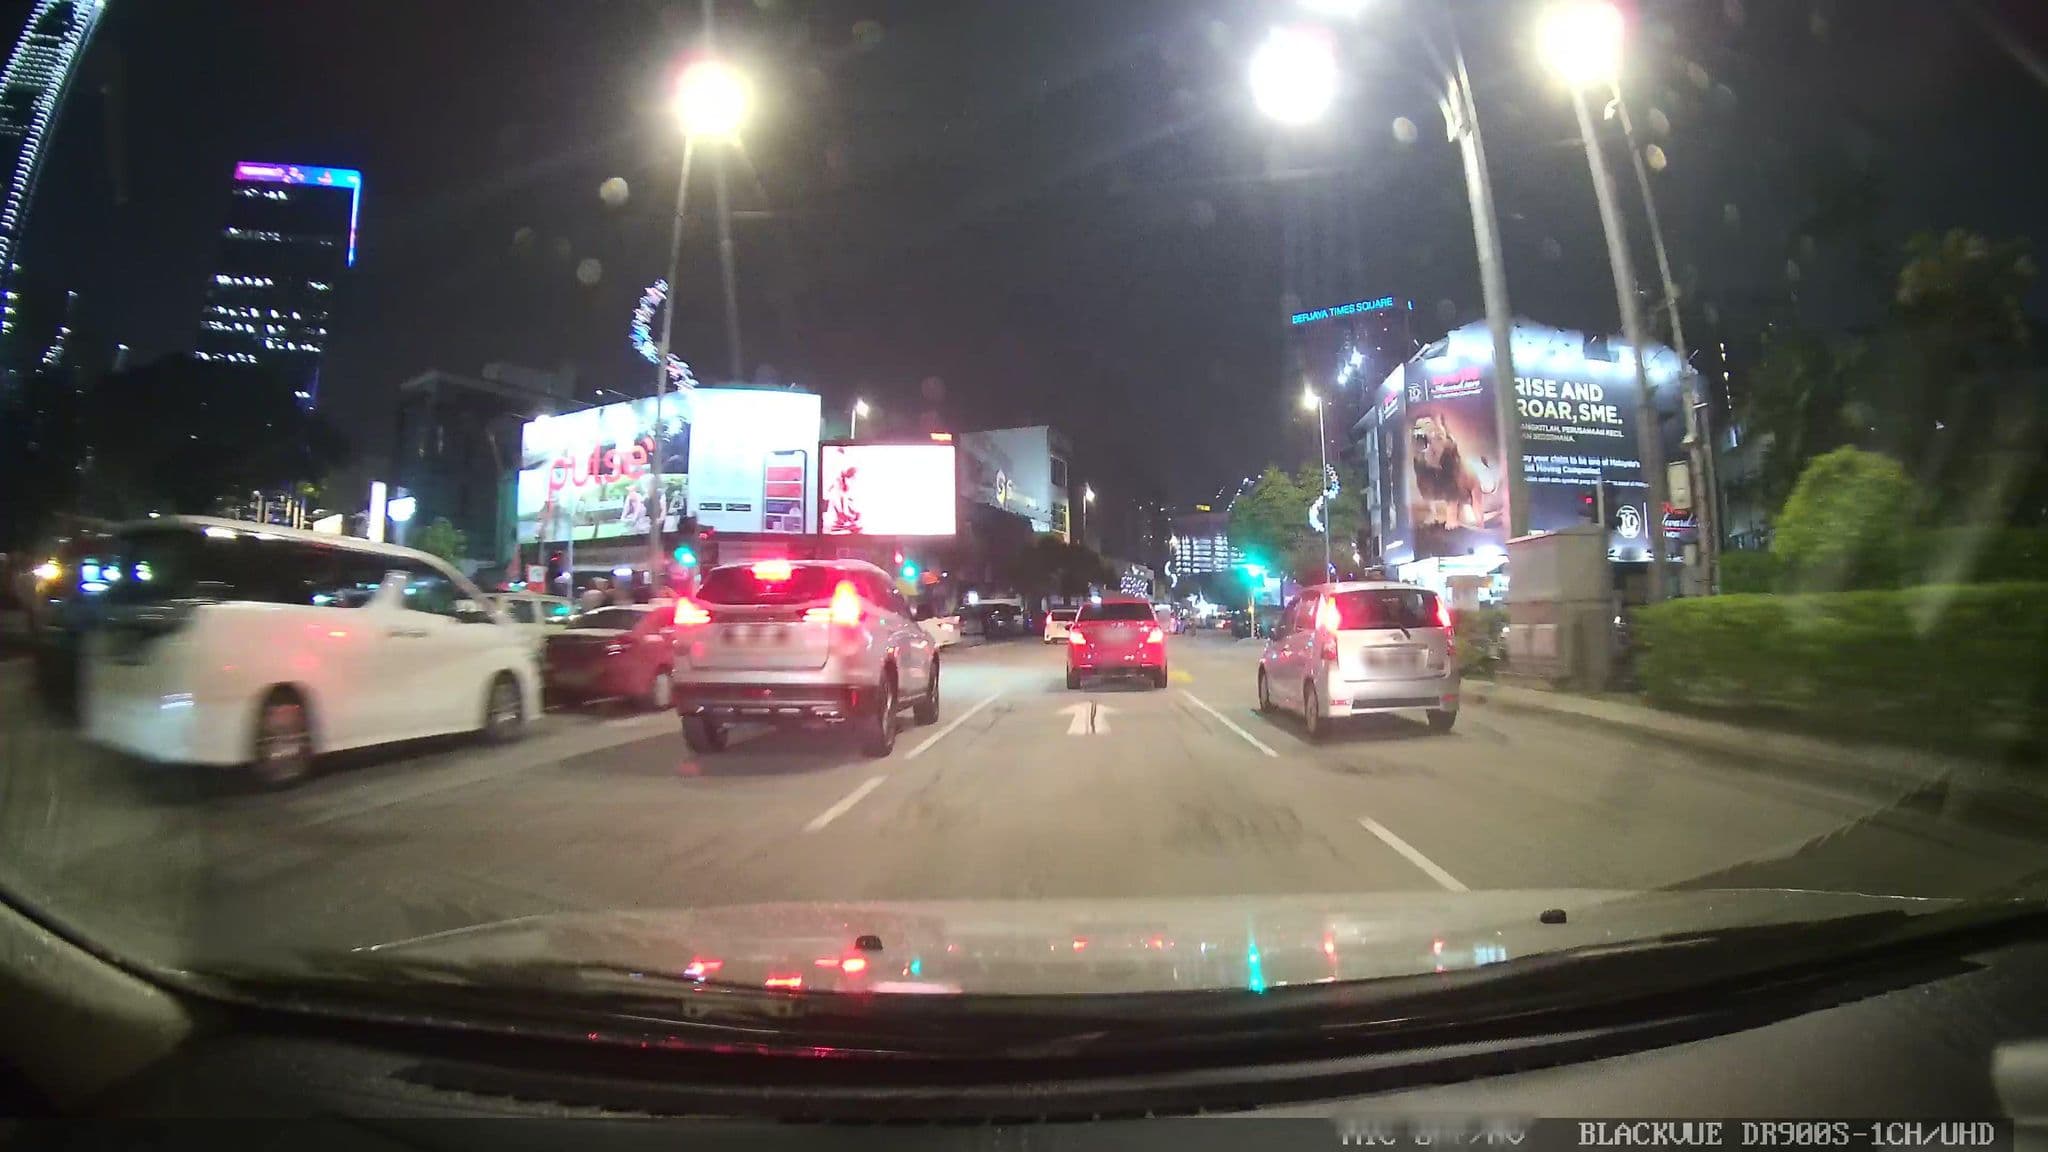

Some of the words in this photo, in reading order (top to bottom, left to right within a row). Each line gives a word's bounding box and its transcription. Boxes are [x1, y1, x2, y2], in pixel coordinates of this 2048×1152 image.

[1292, 310, 1329, 324] BERJAYA
[1329, 303, 1356, 317] TIMES
[1356, 297, 1393, 312] SQUARE
[1513, 377, 1558, 399] RISE
[1561, 381, 1604, 402] AND
[1516, 398, 1577, 423] ROAR,
[1578, 403, 1624, 425] SME.
[548, 440, 648, 512] pulse
